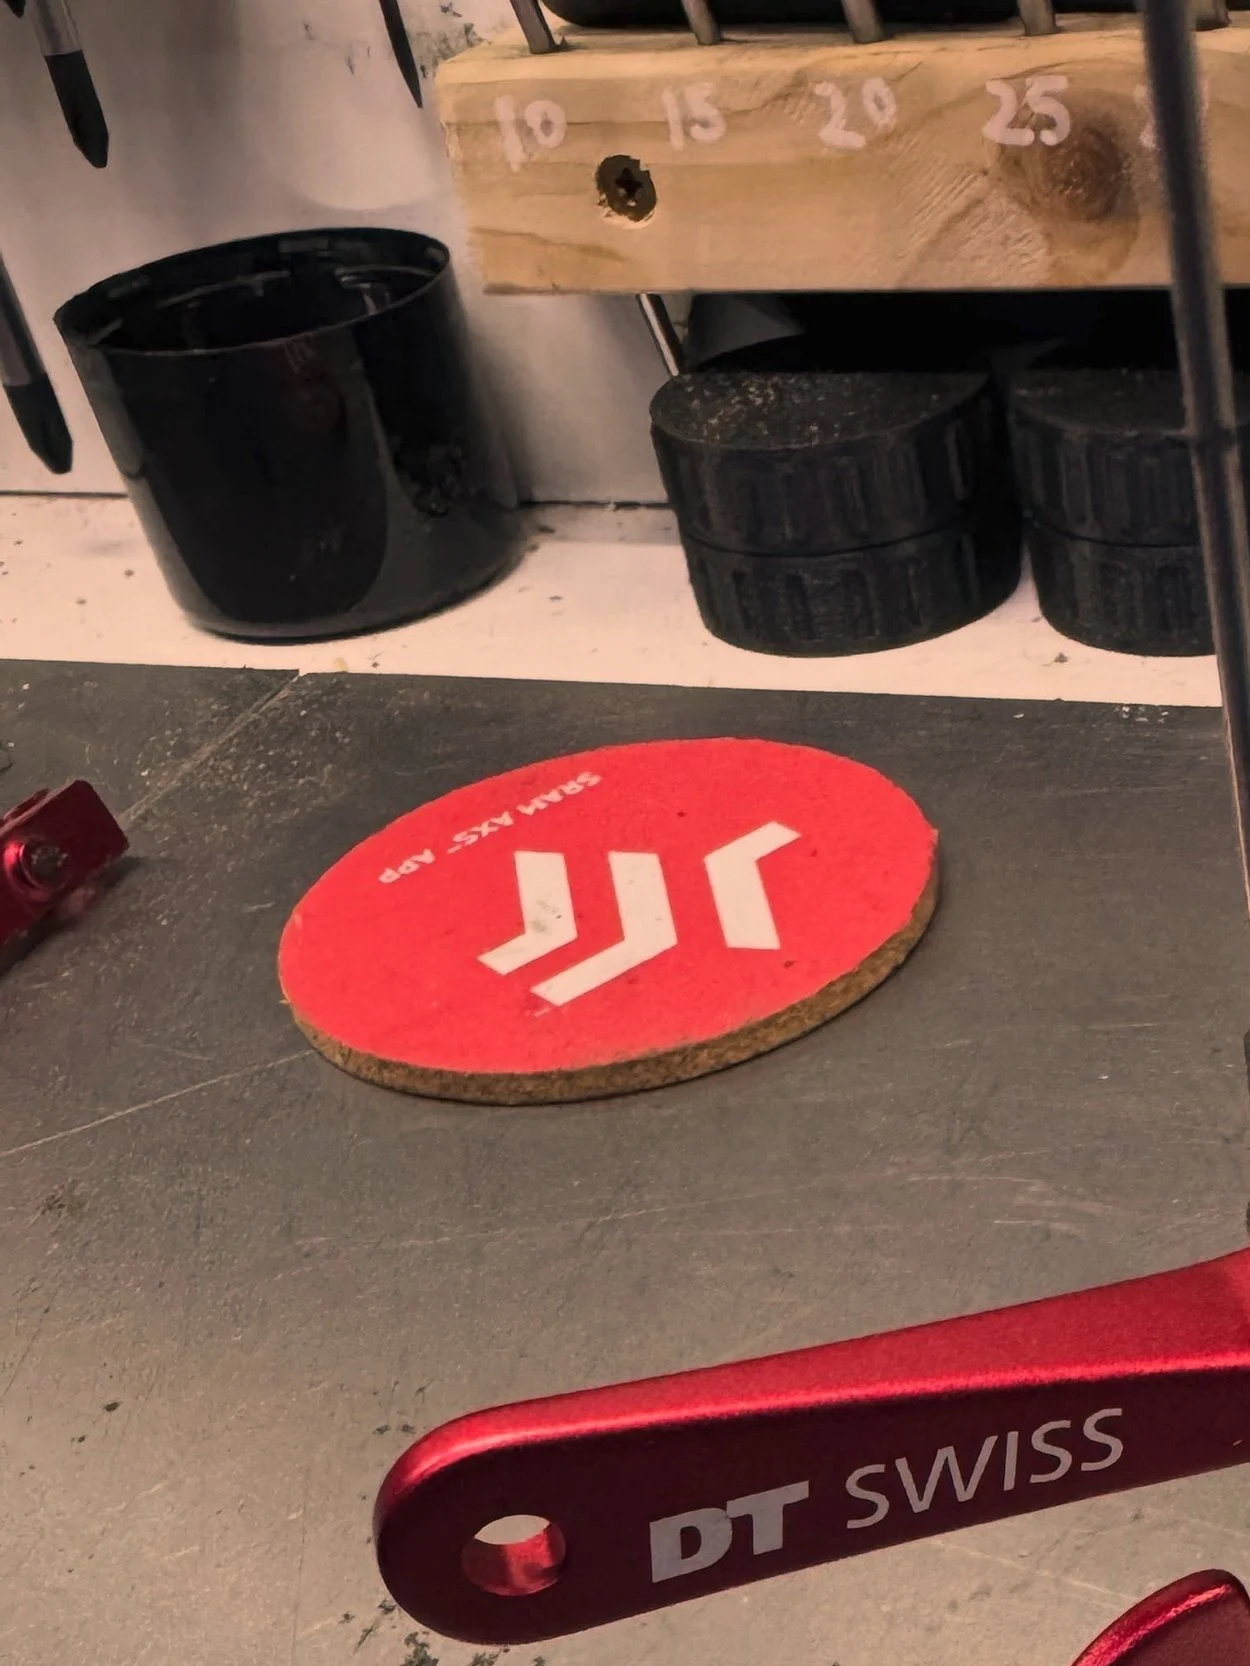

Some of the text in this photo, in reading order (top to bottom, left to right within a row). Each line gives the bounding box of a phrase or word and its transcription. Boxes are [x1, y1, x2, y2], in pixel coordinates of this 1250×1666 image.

[494, 94, 567, 171] 10
[662, 81, 727, 149] 15
[814, 77, 897, 149] 20
[982, 74, 1071, 146] 25
[516, 771, 602, 816] SRAM
[378, 848, 436, 884] APP
[649, 1407, 1125, 1583] DT SWISS
